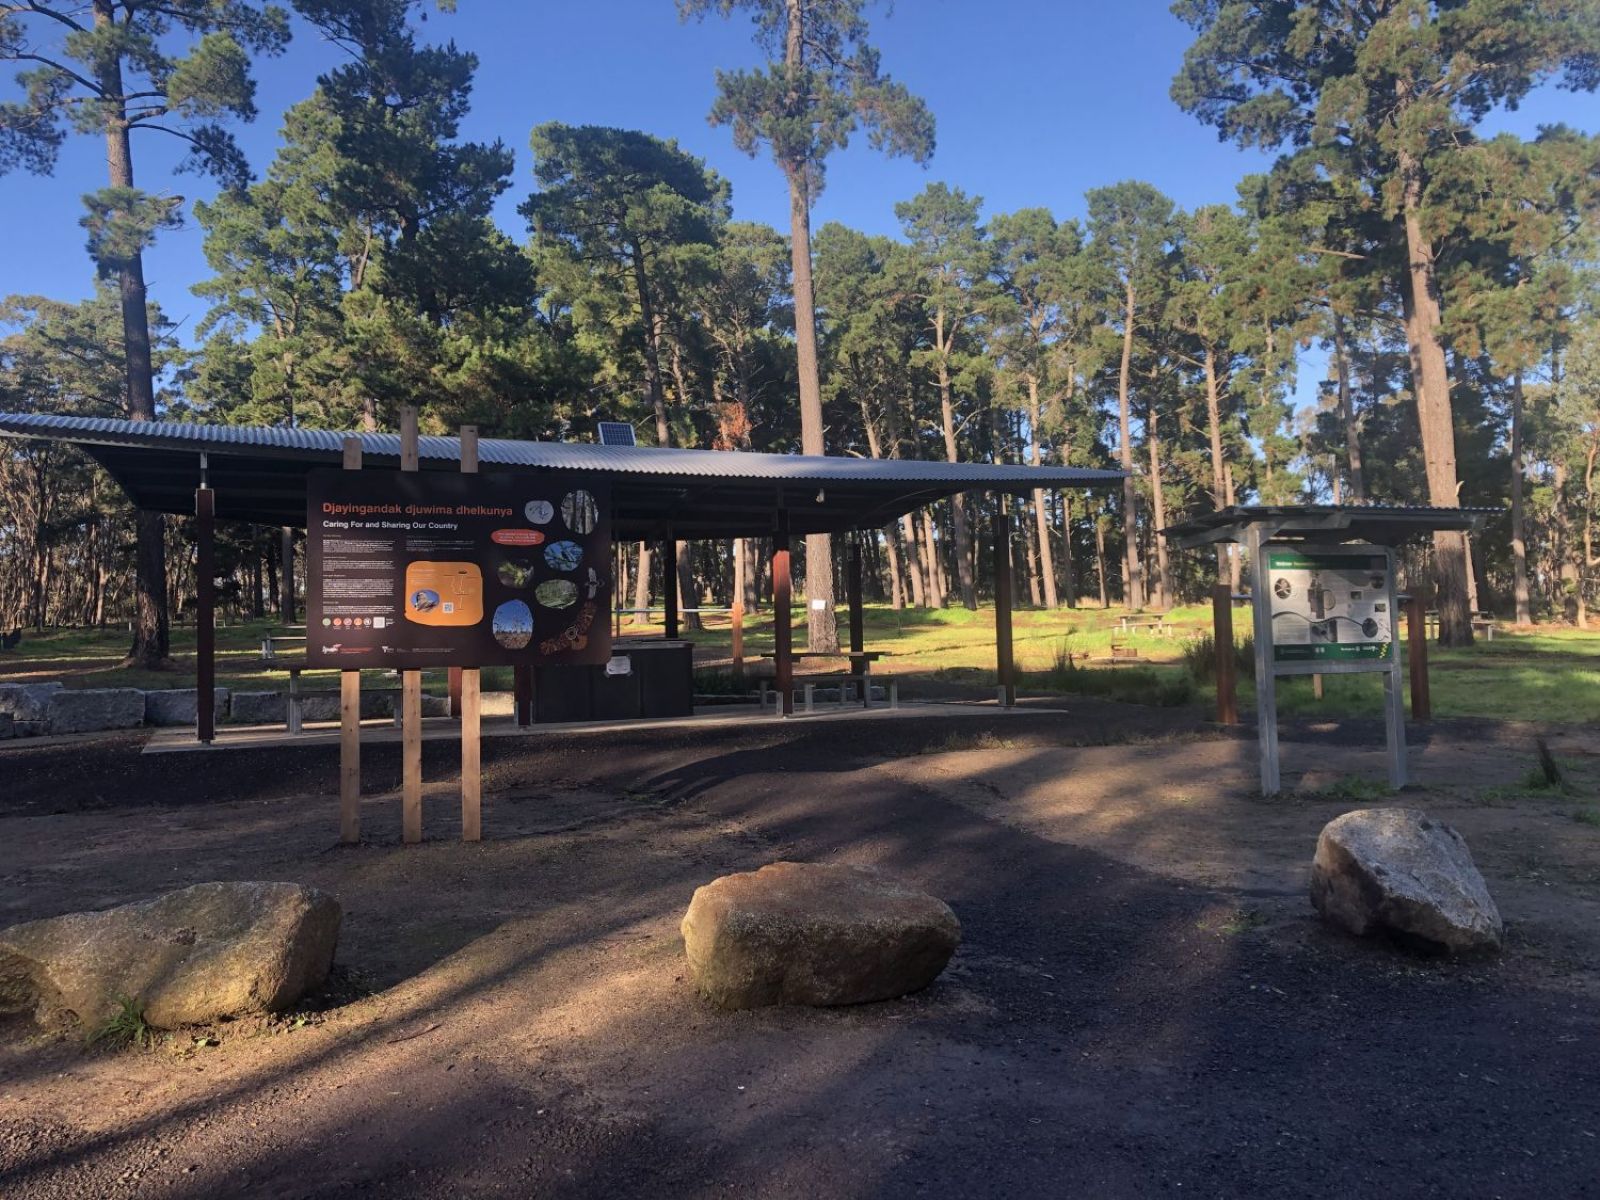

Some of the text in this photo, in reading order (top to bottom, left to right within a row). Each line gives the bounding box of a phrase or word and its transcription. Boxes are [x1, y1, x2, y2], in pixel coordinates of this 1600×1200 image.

[322, 502, 513, 517] Djayingandak djuwima dhelkunya
[322, 520, 349, 529] Caring
[381, 521, 411, 530] Sharing
[428, 522, 458, 531] Country
